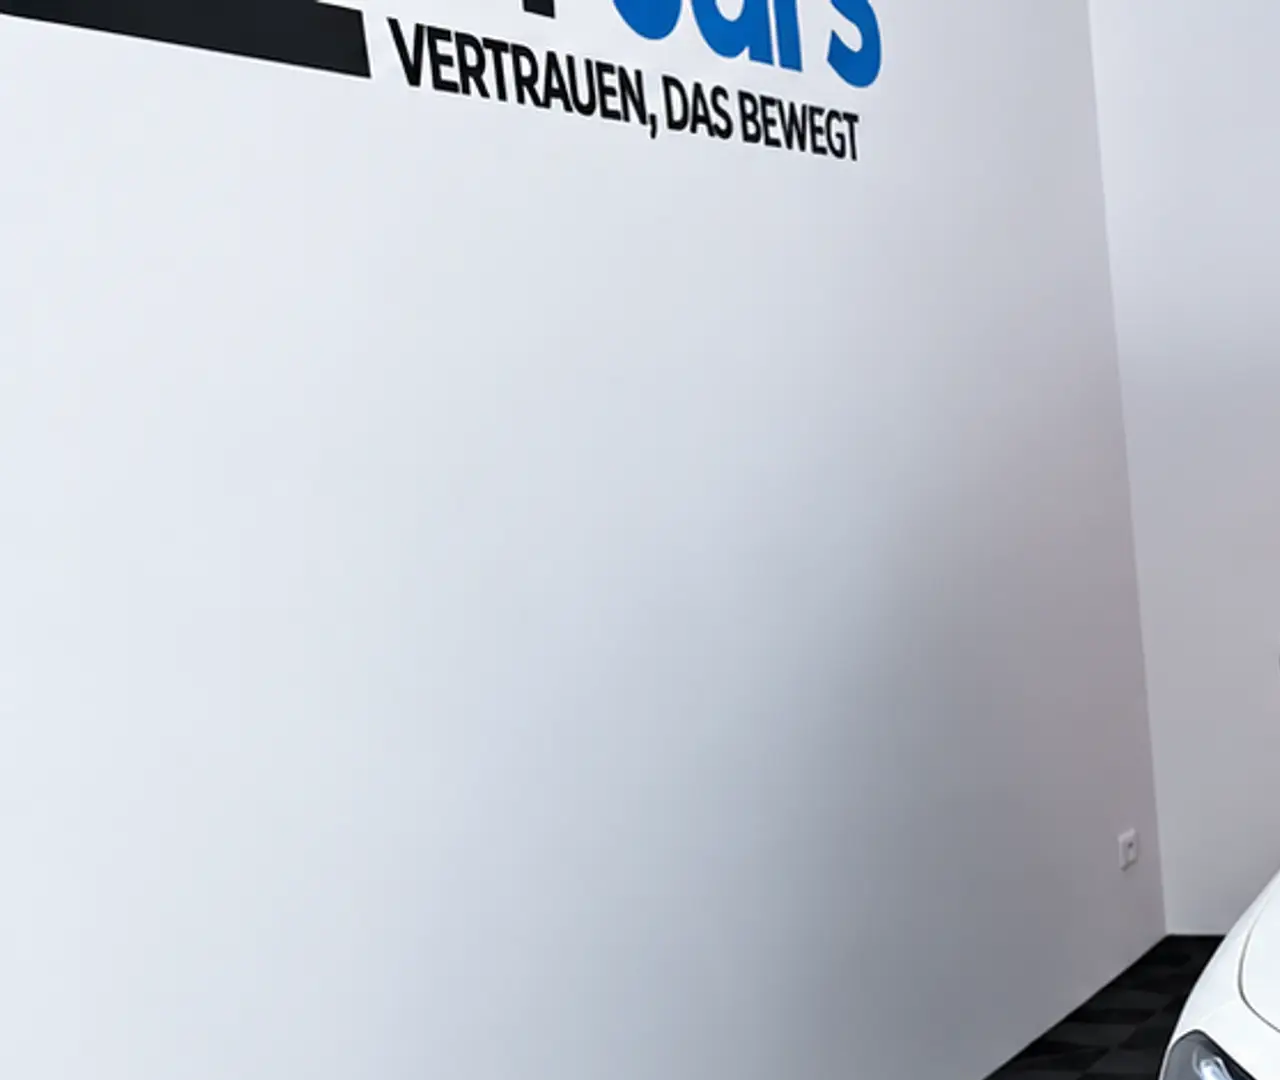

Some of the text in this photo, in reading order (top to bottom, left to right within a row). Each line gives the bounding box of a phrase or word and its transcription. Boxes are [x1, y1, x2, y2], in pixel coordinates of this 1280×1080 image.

[387, 18, 658, 140] VERTRAUEN,
[661, 75, 734, 140] DAS
[737, 90, 859, 161] BEWEGT
